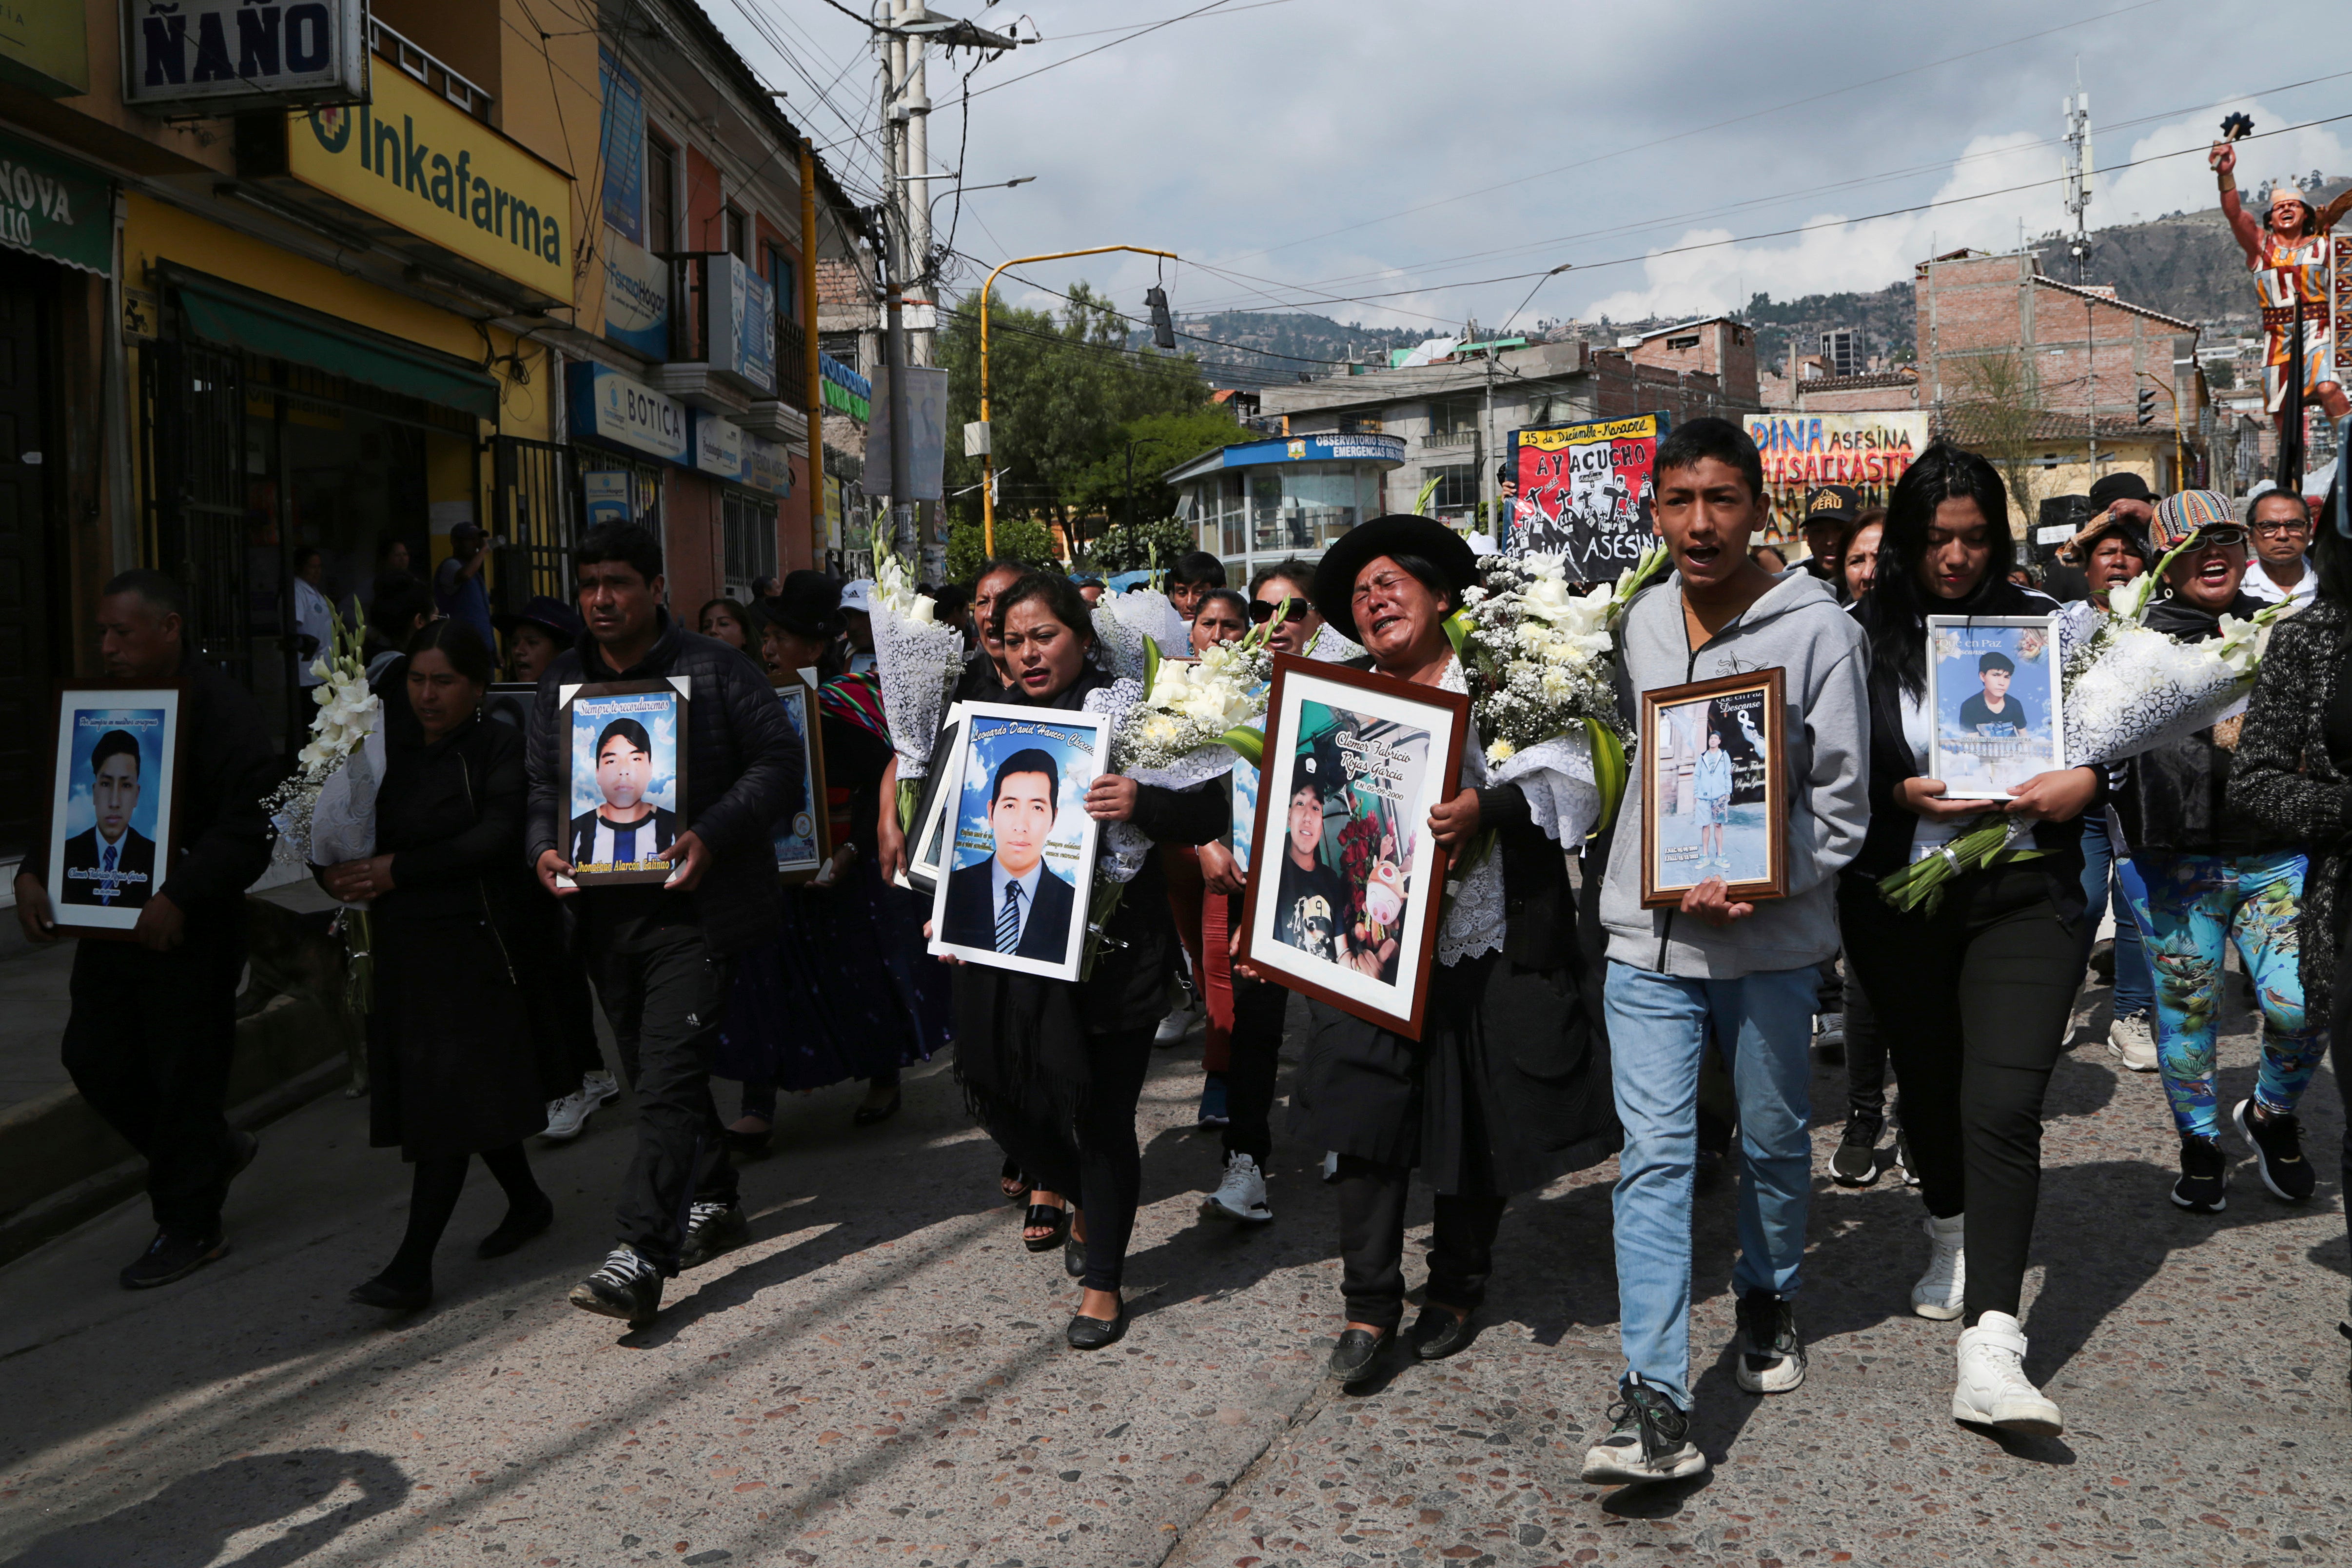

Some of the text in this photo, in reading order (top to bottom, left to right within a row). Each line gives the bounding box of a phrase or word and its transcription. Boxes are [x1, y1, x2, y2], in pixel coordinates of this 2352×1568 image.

[142, 0, 331, 87] ÑAÑO
[360, 104, 561, 267] Inkafarma
[628, 388, 681, 439] BOTICA
[1316, 435, 1377, 447] OBSERVATORIO
[1525, 433, 1538, 444] 15
[1543, 435, 1553, 444] de
[1333, 446, 1385, 458] EMERGENCIAS
[1536, 444, 1646, 476] AYACUCHO
[1775, 488, 1798, 509] LA
[1940, 639, 1962, 652] Que
[1982, 639, 2002, 647] Paz
[580, 698, 669, 718] Siempre te recordaremos
[1720, 701, 1762, 713] Descanse
[971, 723, 1007, 743] Leonardo
[1009, 722, 1034, 734] David
[1337, 733, 1411, 763] Clemer Fabricio
[1342, 753, 1404, 781] Rojas Garcia
[1367, 785, 1404, 801] 05-09-2000
[575, 860, 612, 873] Jhonathan
[614, 859, 641, 871] Alarcón
[1315, 900, 1322, 920] 9
